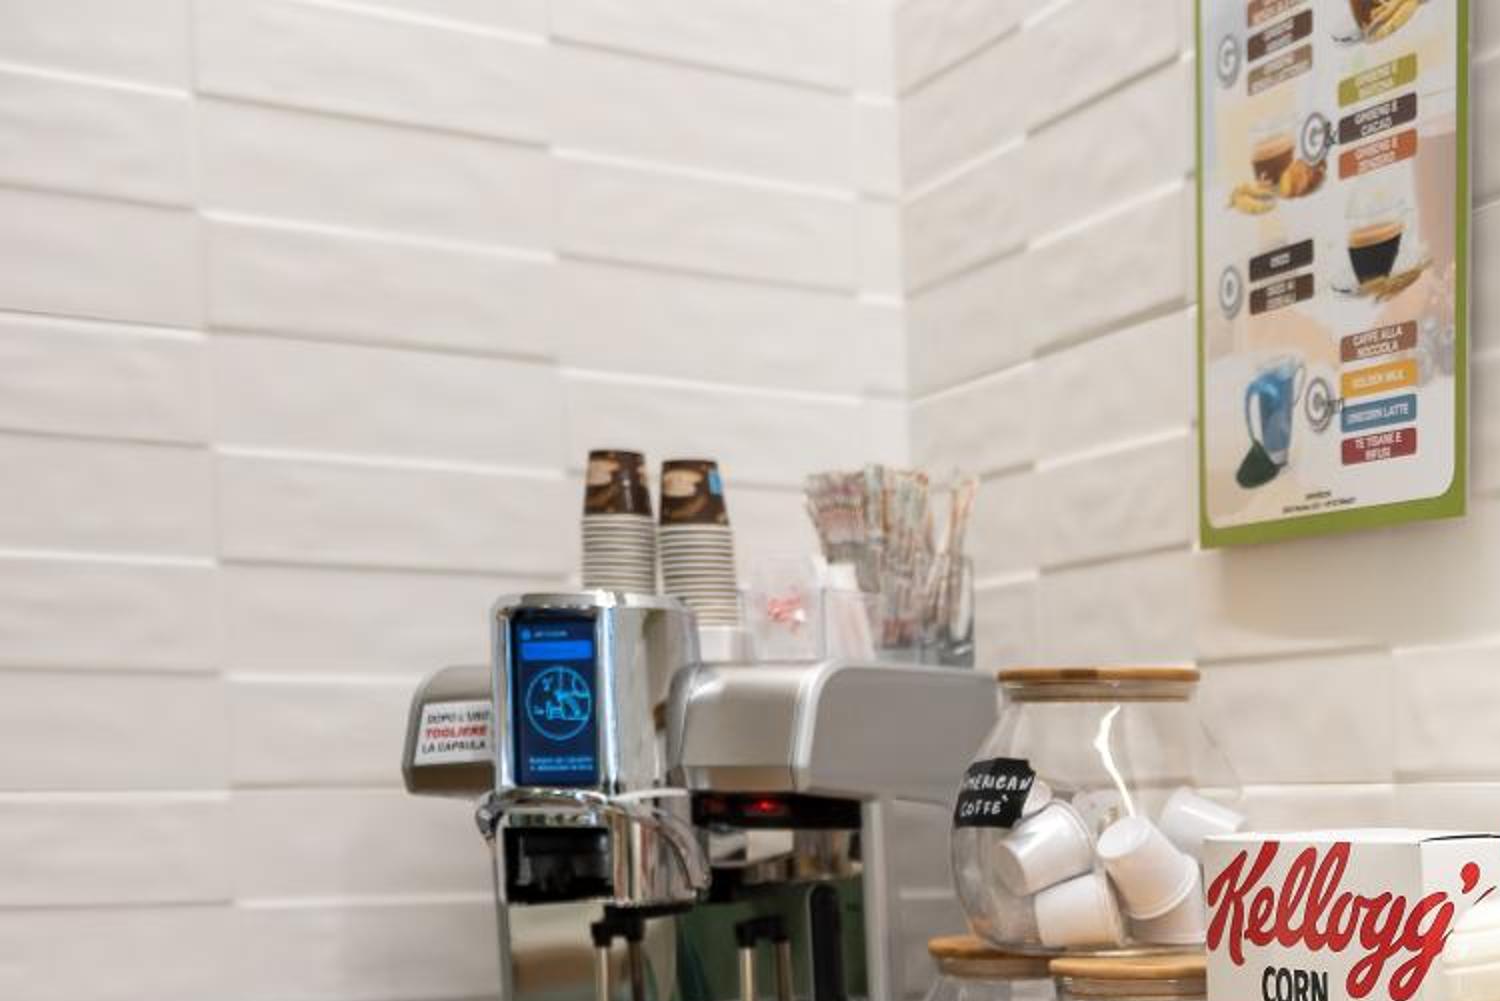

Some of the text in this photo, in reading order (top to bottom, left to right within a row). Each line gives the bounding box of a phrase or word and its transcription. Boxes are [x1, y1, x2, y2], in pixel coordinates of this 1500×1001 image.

[1383, 403, 1409, 417] LATTE
[426, 724, 487, 738] TOGLIERE
[421, 740, 486, 754] LA CAPSULA
